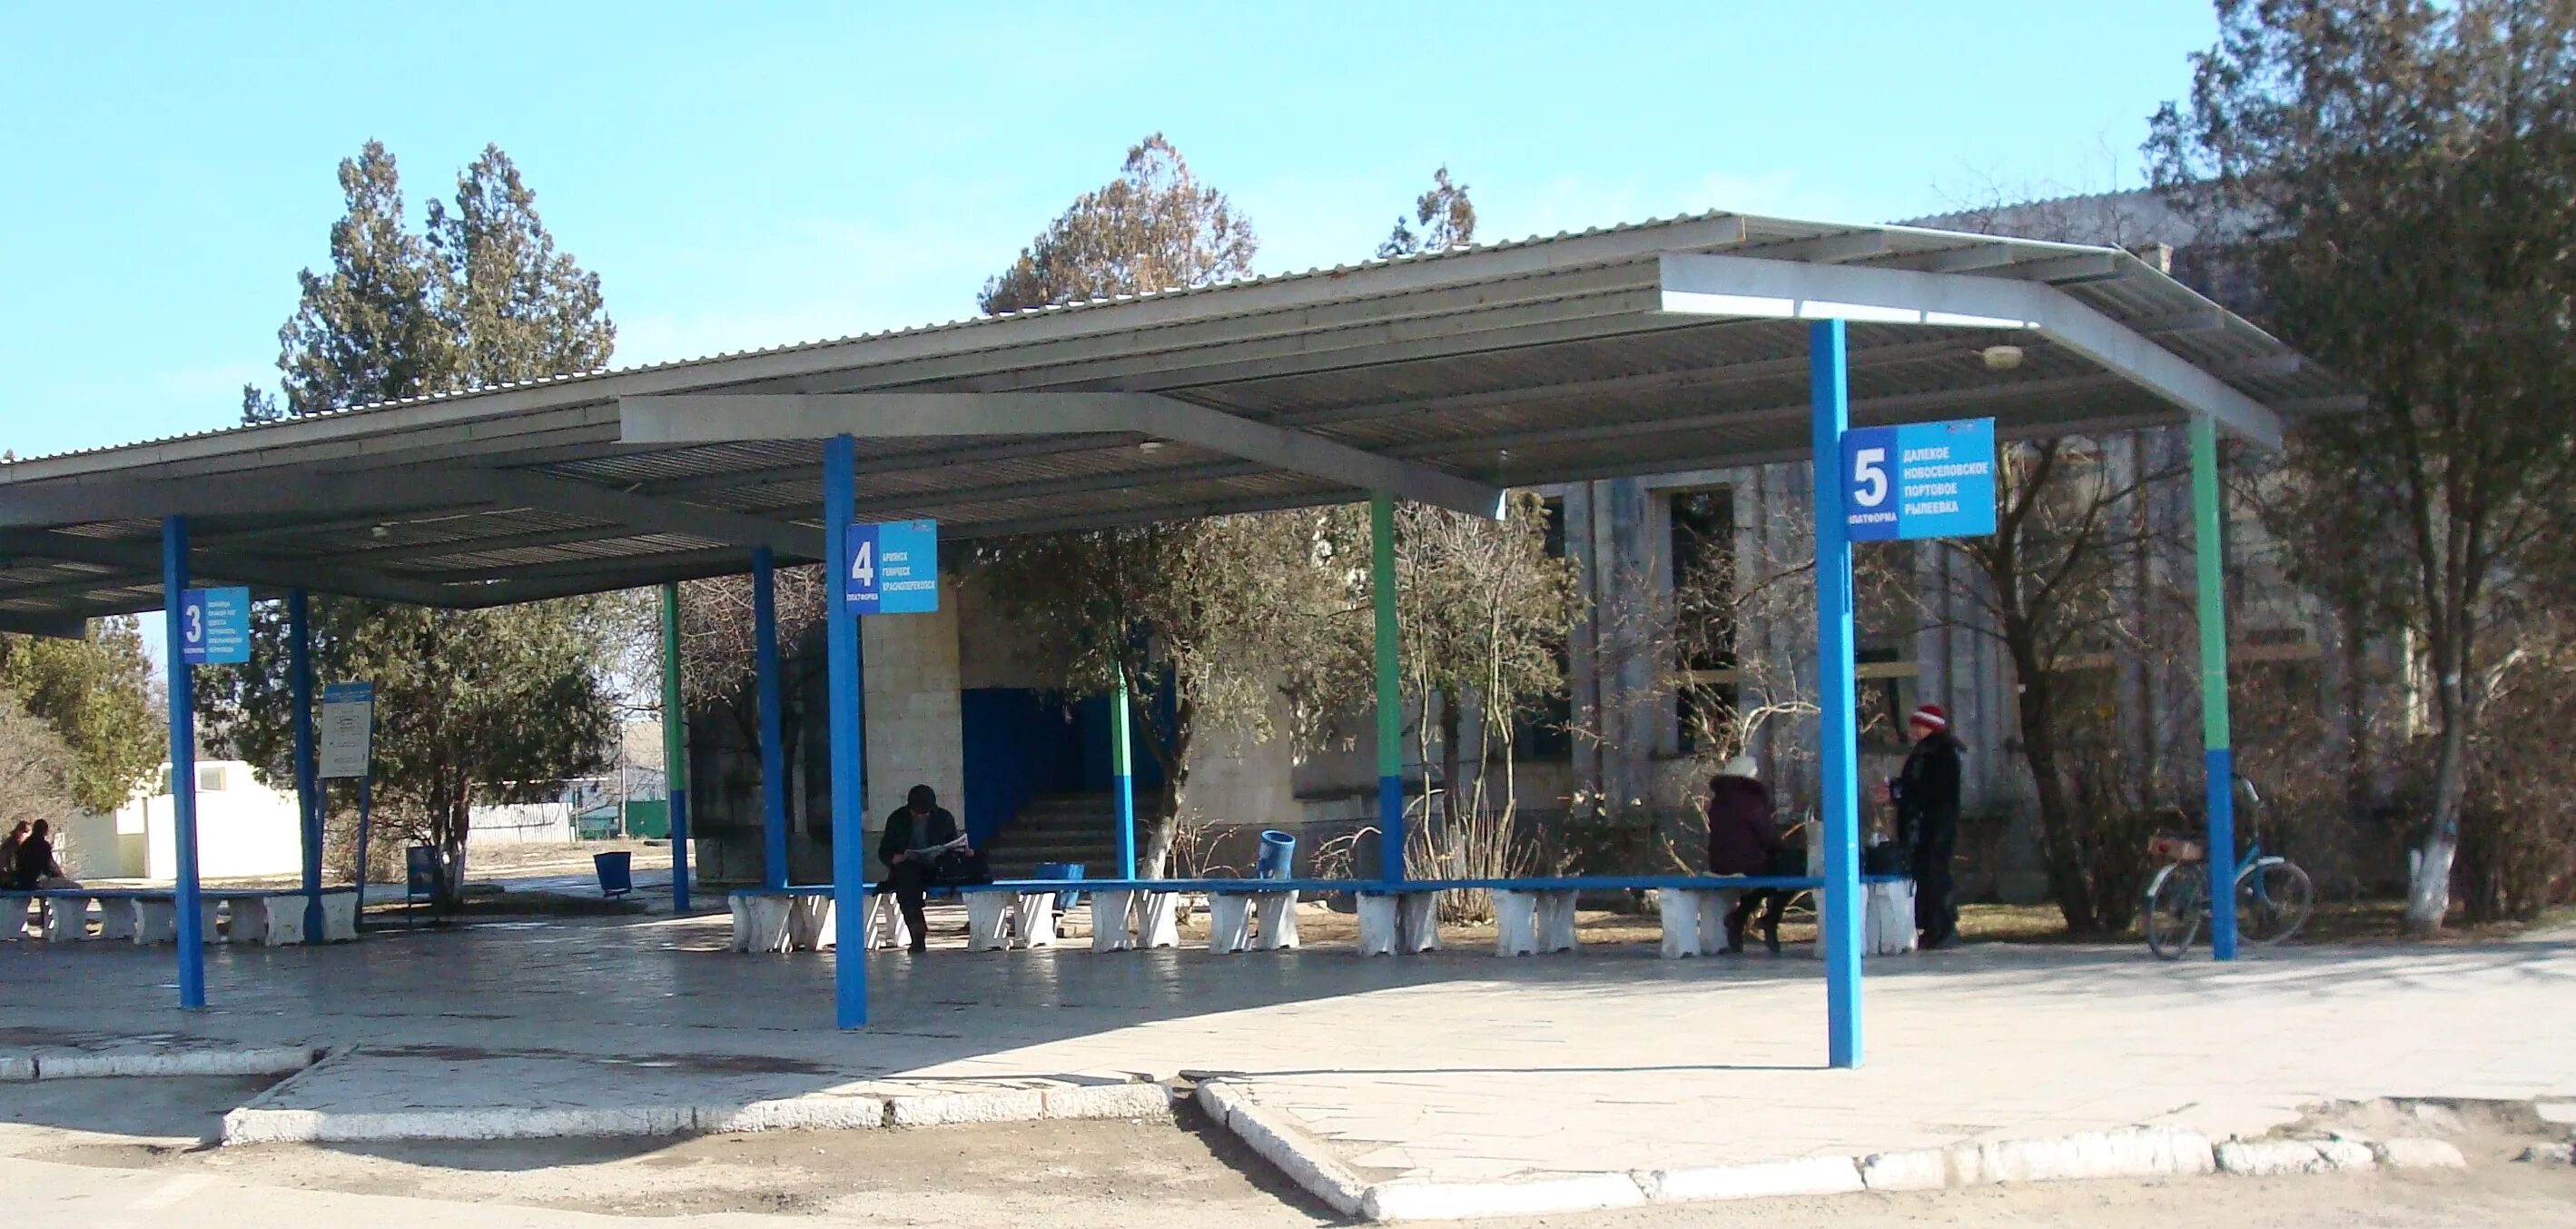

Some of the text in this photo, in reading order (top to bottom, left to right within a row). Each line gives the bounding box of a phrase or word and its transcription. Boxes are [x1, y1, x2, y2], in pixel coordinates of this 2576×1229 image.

[1903, 447, 1950, 463] ДАЛЕКОЕ
[1854, 448, 1889, 507] 5
[1903, 462, 1989, 480] НОВОСЕЛОВСКОЕ
[1904, 482, 1959, 498] ПОРТОВОЕ
[1904, 501, 1959, 516] РЫЛЕЕВКА
[852, 541, 873, 587] 4
[186, 604, 202, 643] 3
